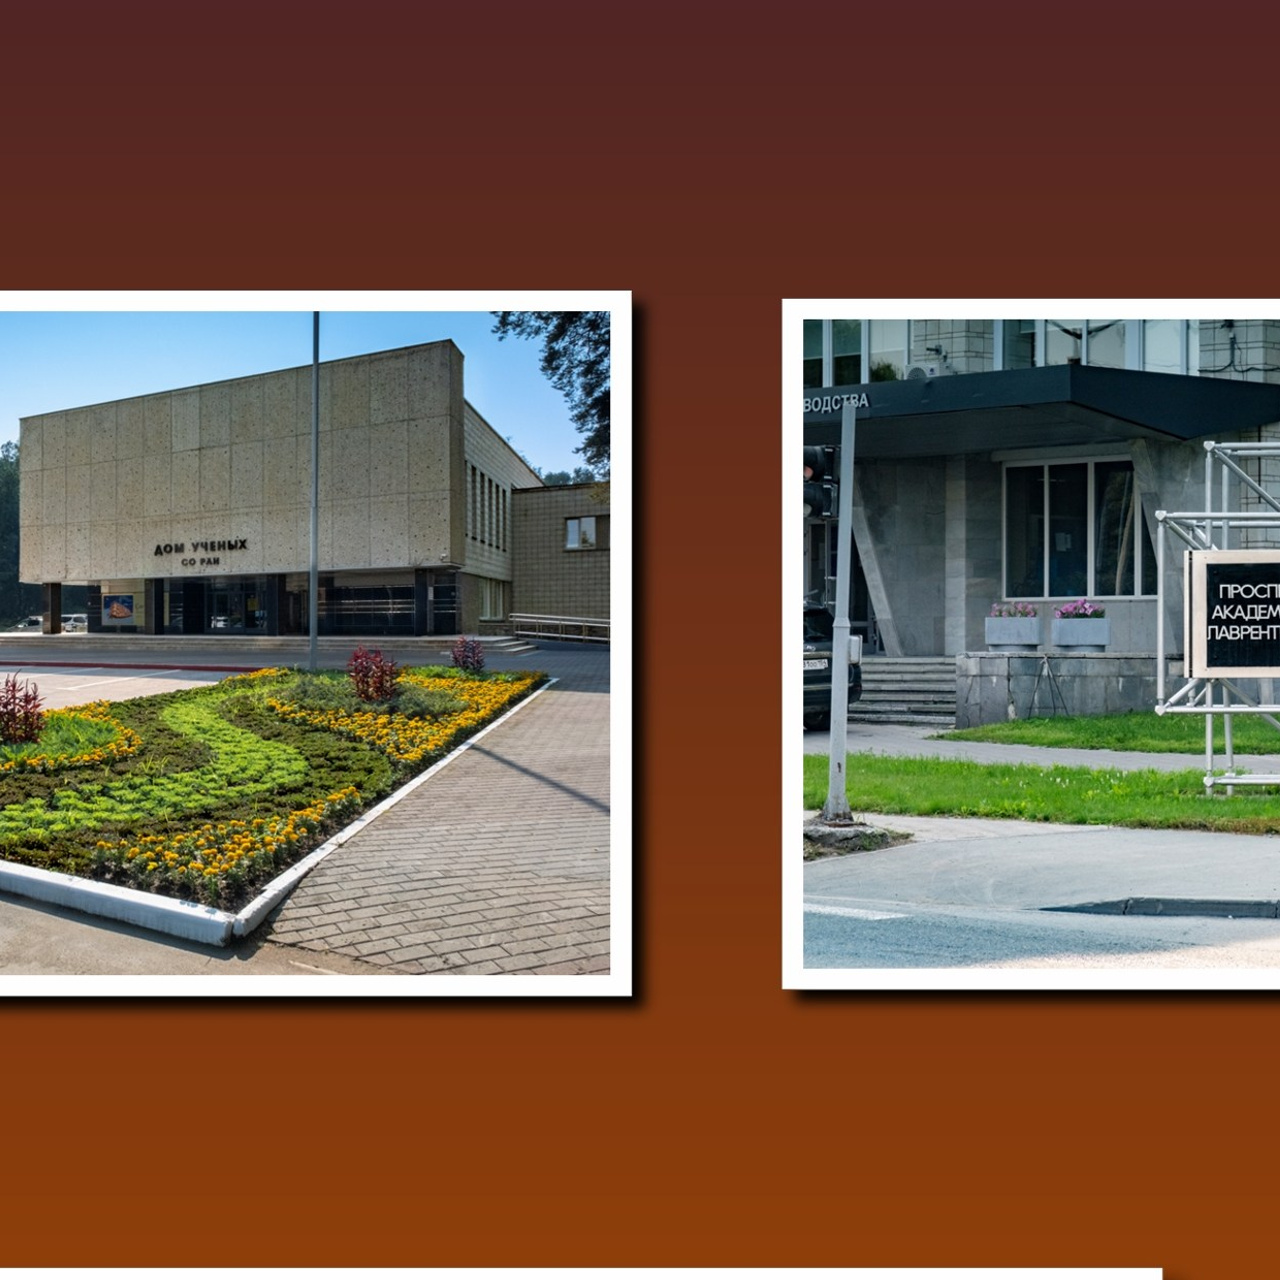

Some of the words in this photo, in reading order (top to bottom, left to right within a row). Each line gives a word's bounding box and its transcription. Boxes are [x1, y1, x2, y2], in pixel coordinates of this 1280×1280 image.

[803, 393, 869, 414] ВОДСТВА
[154, 543, 185, 556] ДОМ
[191, 539, 248, 552] УЧЕНЫХ
[181, 558, 197, 566] СО
[200, 557, 220, 566] РАН
